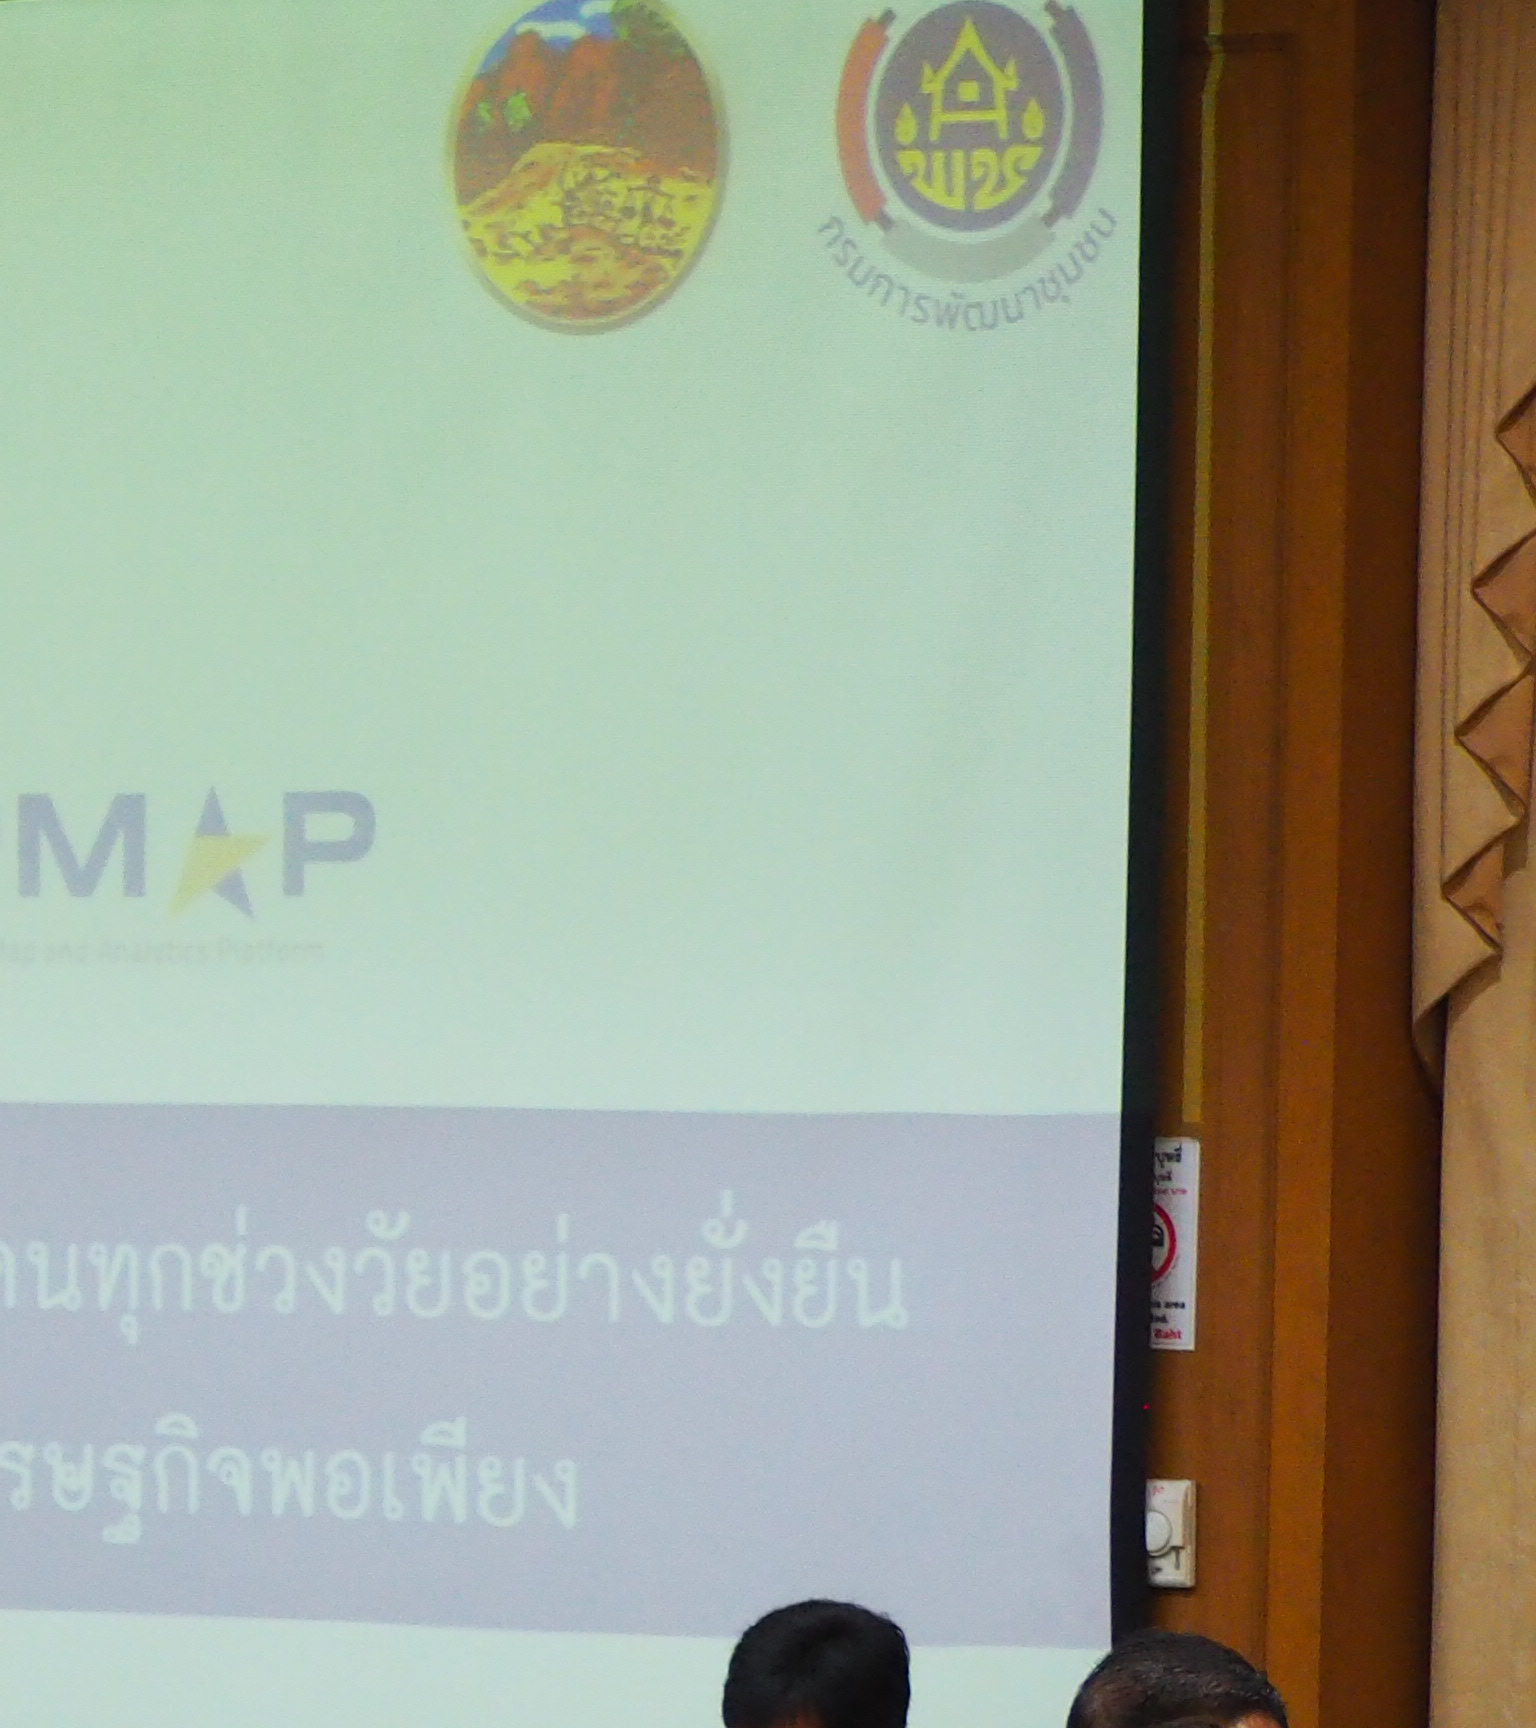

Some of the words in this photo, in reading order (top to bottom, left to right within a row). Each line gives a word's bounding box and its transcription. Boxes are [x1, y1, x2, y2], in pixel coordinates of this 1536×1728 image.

[817, 206, 1118, 332] กรมการพัฒนาชุมชน
